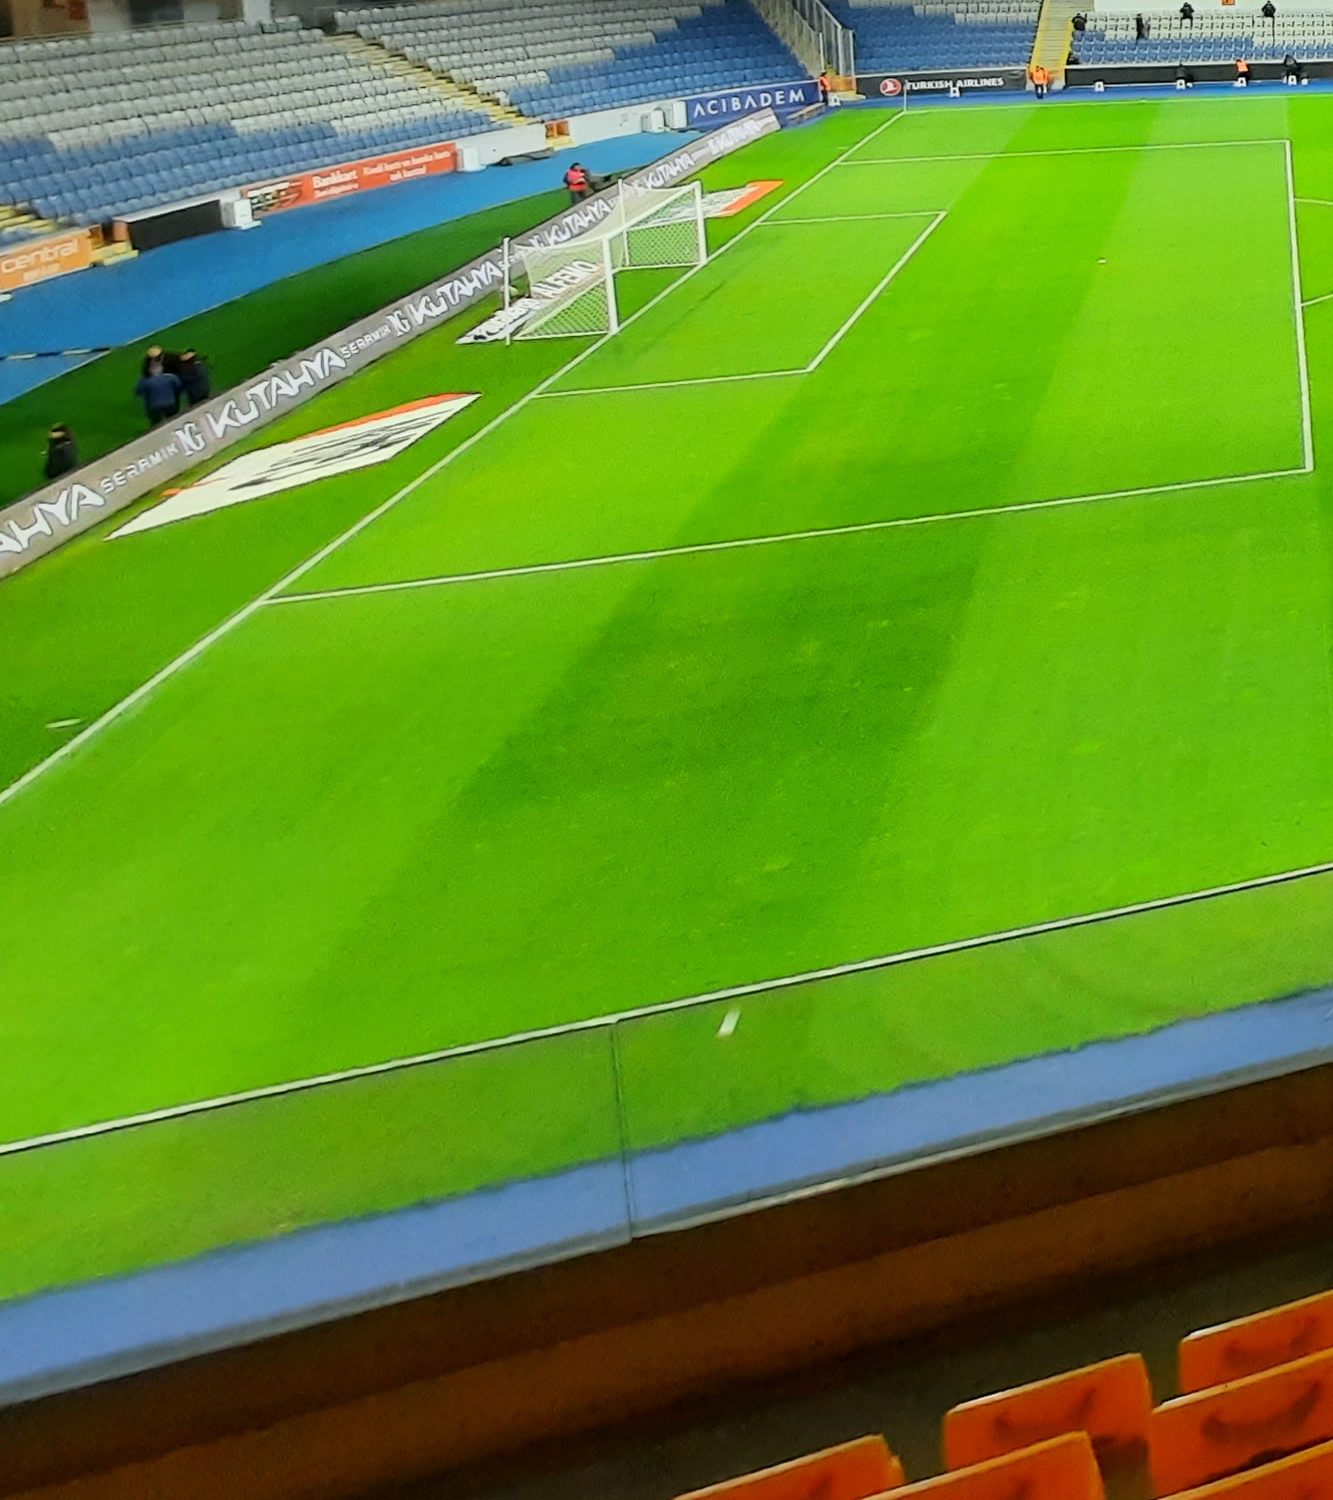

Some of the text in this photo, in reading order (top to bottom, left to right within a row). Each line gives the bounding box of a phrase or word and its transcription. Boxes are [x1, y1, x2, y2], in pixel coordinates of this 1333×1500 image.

[906, 77, 1005, 91] TURKISH AIRLINES
[693, 88, 806, 118] ACIBADEM
[1, 238, 79, 274] central
[174, 421, 206, 457] NG
[101, 442, 181, 495] SERAMIK
